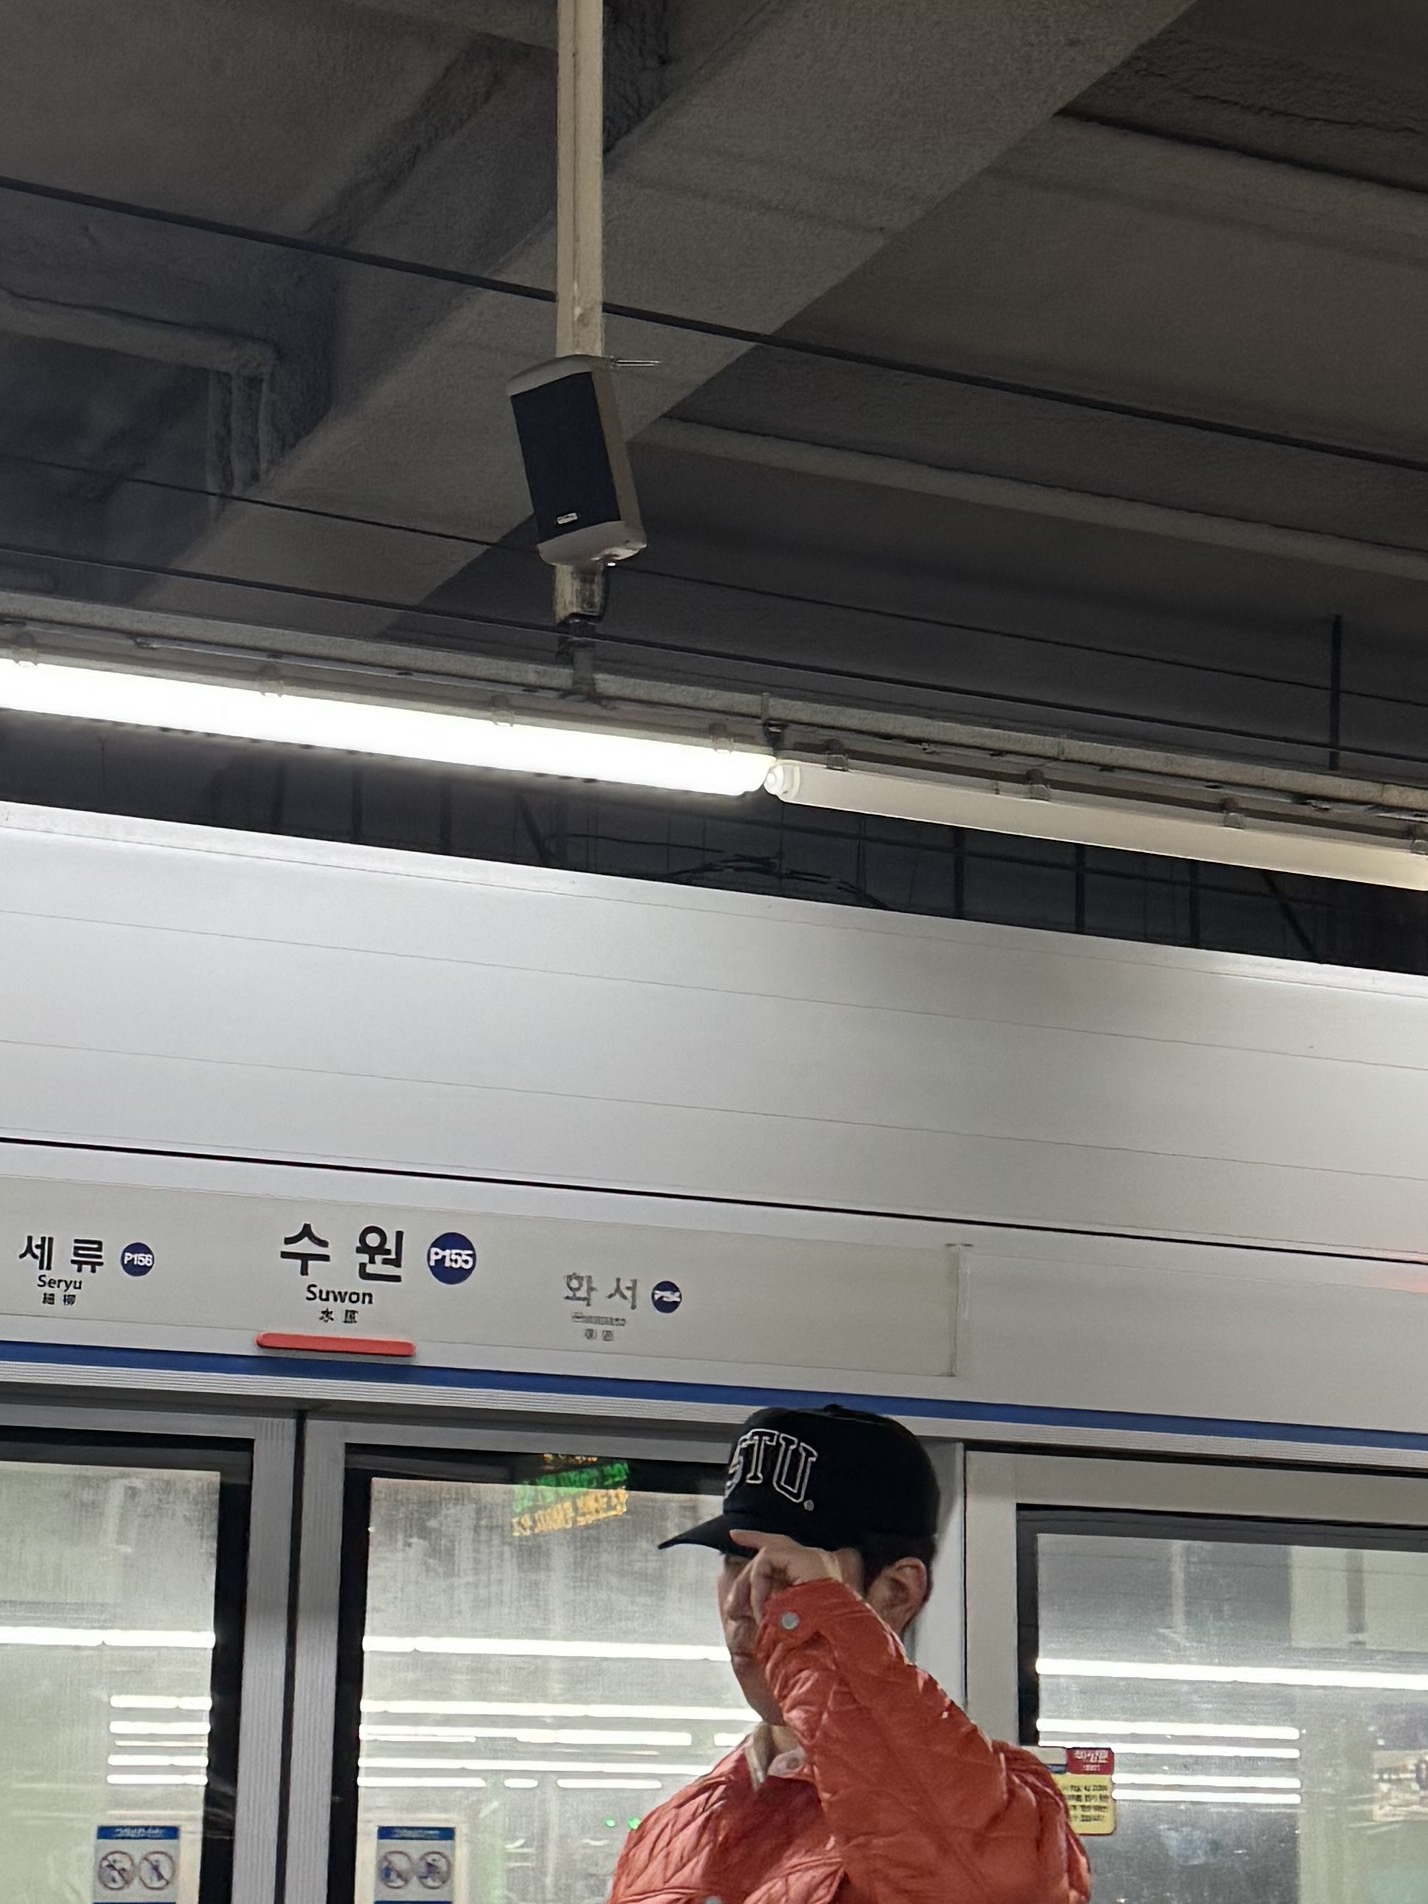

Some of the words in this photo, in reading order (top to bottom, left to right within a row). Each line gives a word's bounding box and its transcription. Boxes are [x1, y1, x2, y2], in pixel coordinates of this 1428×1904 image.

[19, 1235, 104, 1273] 세류
[280, 1222, 404, 1283] 수원
[430, 1247, 473, 1270] P155
[37, 1274, 83, 1292] Seryu
[306, 1284, 373, 1304] Suwon
